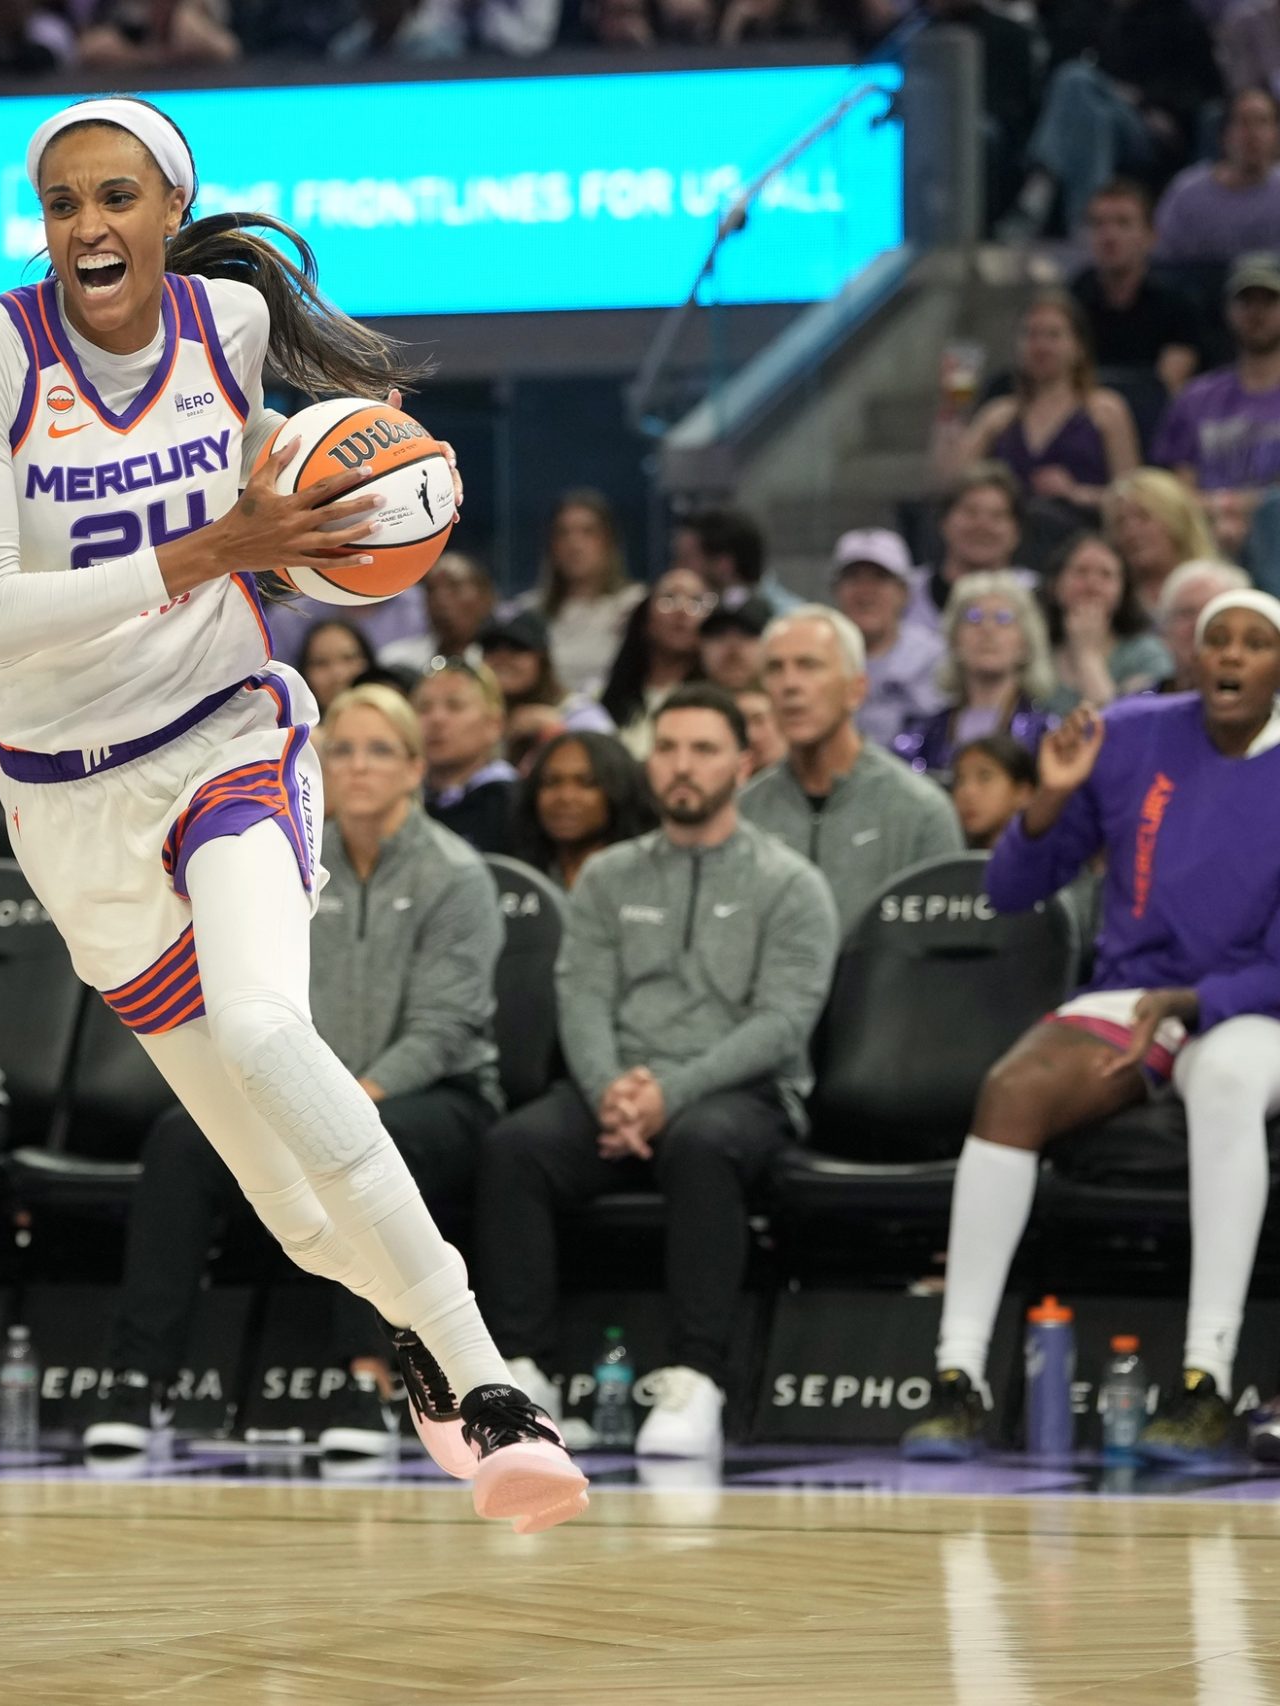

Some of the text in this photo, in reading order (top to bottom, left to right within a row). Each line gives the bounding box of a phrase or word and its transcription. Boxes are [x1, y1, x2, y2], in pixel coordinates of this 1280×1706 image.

[579, 167, 674, 221] FOR
[175, 392, 215, 412] HERO
[25, 429, 231, 503] MERCURY
[70, 489, 214, 570] 24
[376, 515, 397, 523] AME
[480, 1388, 511, 1401] BOOK
